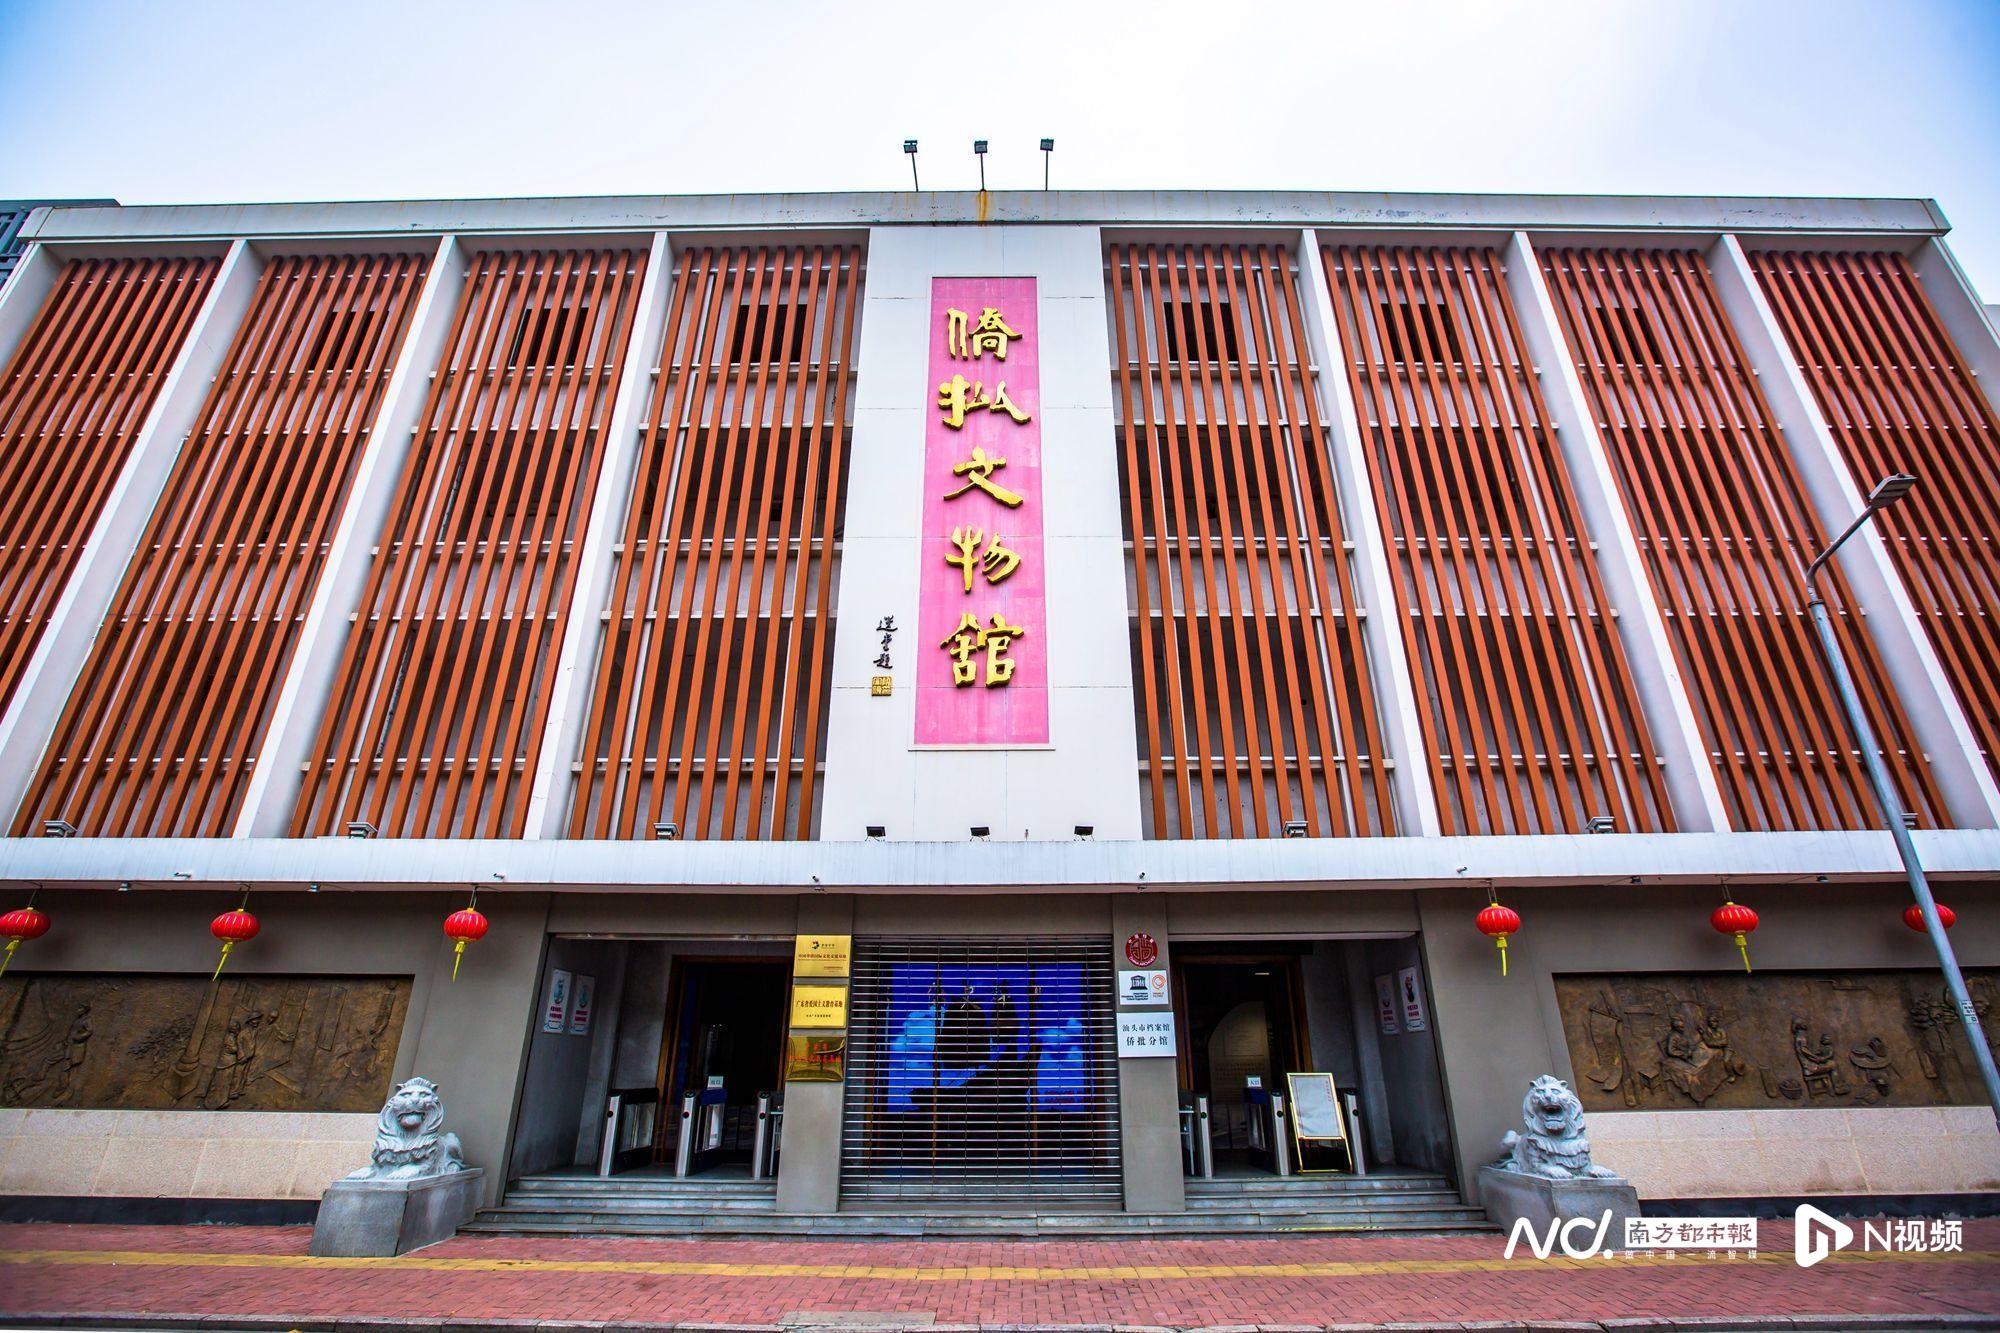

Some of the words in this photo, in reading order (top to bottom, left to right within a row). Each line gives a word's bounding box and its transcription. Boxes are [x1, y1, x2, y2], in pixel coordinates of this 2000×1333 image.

[1122, 1023, 1170, 1032] 汕头市档案馆
[1126, 1036, 1168, 1046] 侨批分馆
